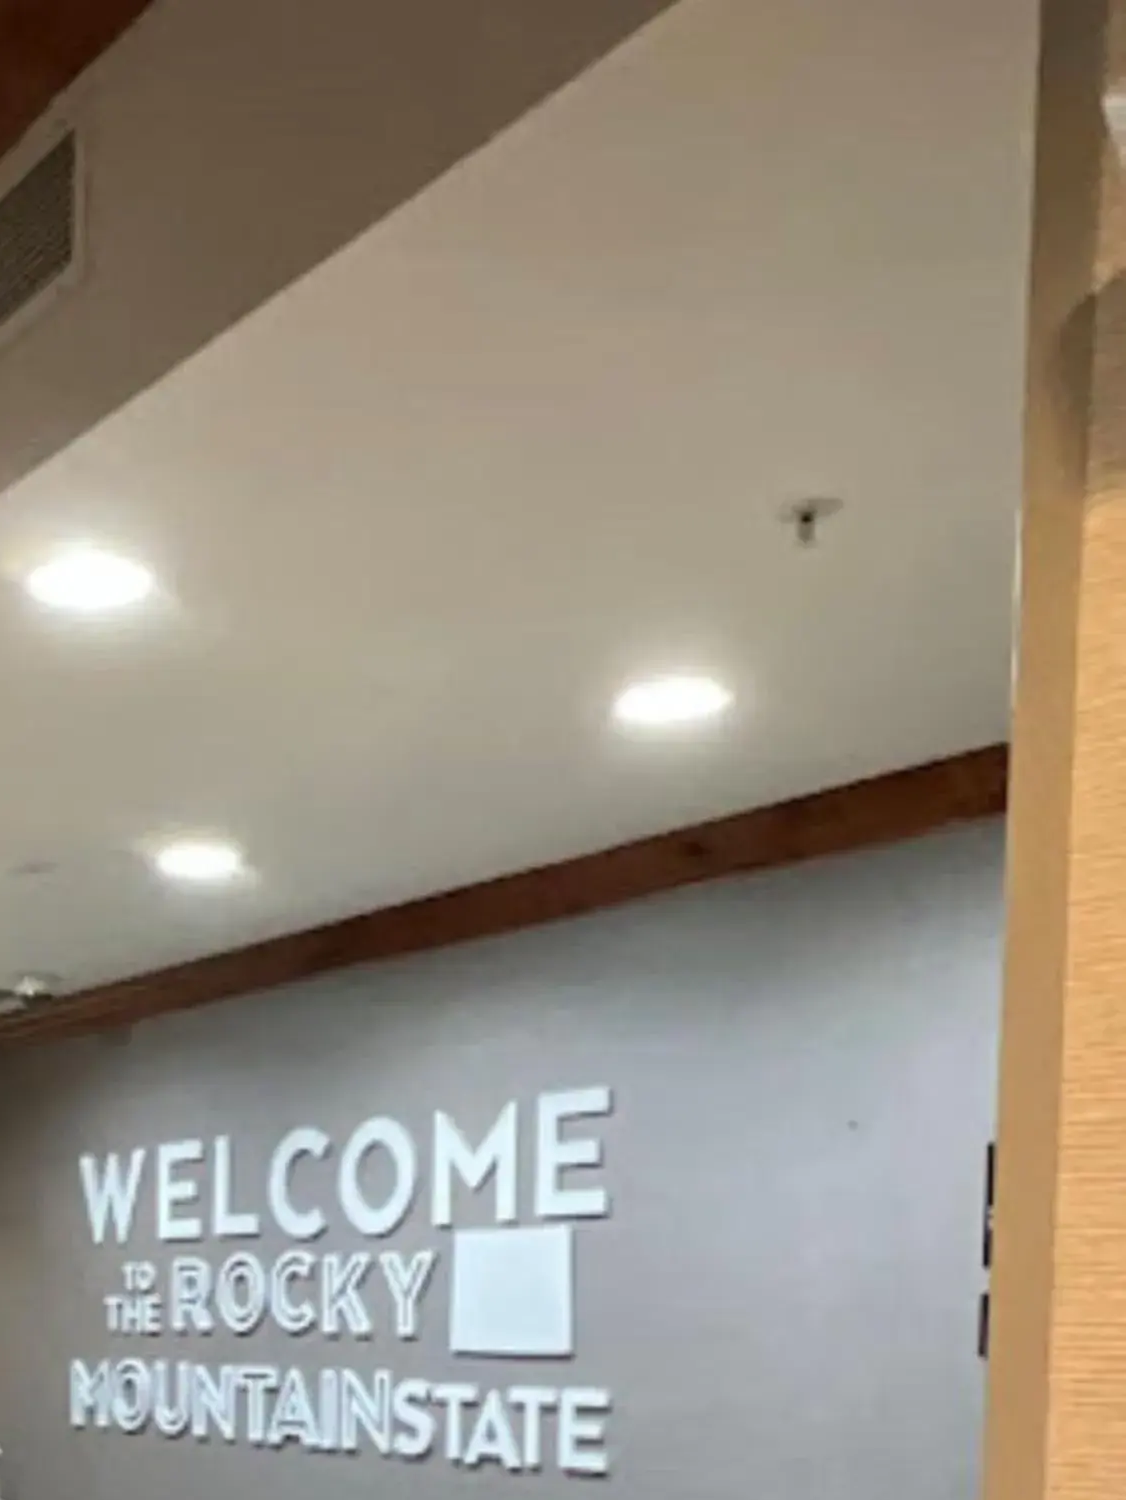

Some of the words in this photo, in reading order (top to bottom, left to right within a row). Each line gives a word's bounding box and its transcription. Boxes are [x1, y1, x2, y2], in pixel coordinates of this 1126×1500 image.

[79, 1086, 611, 1243] WELCOME
[121, 1261, 157, 1294] TO
[173, 1249, 436, 1338] ROCKY
[104, 1296, 163, 1334] THE
